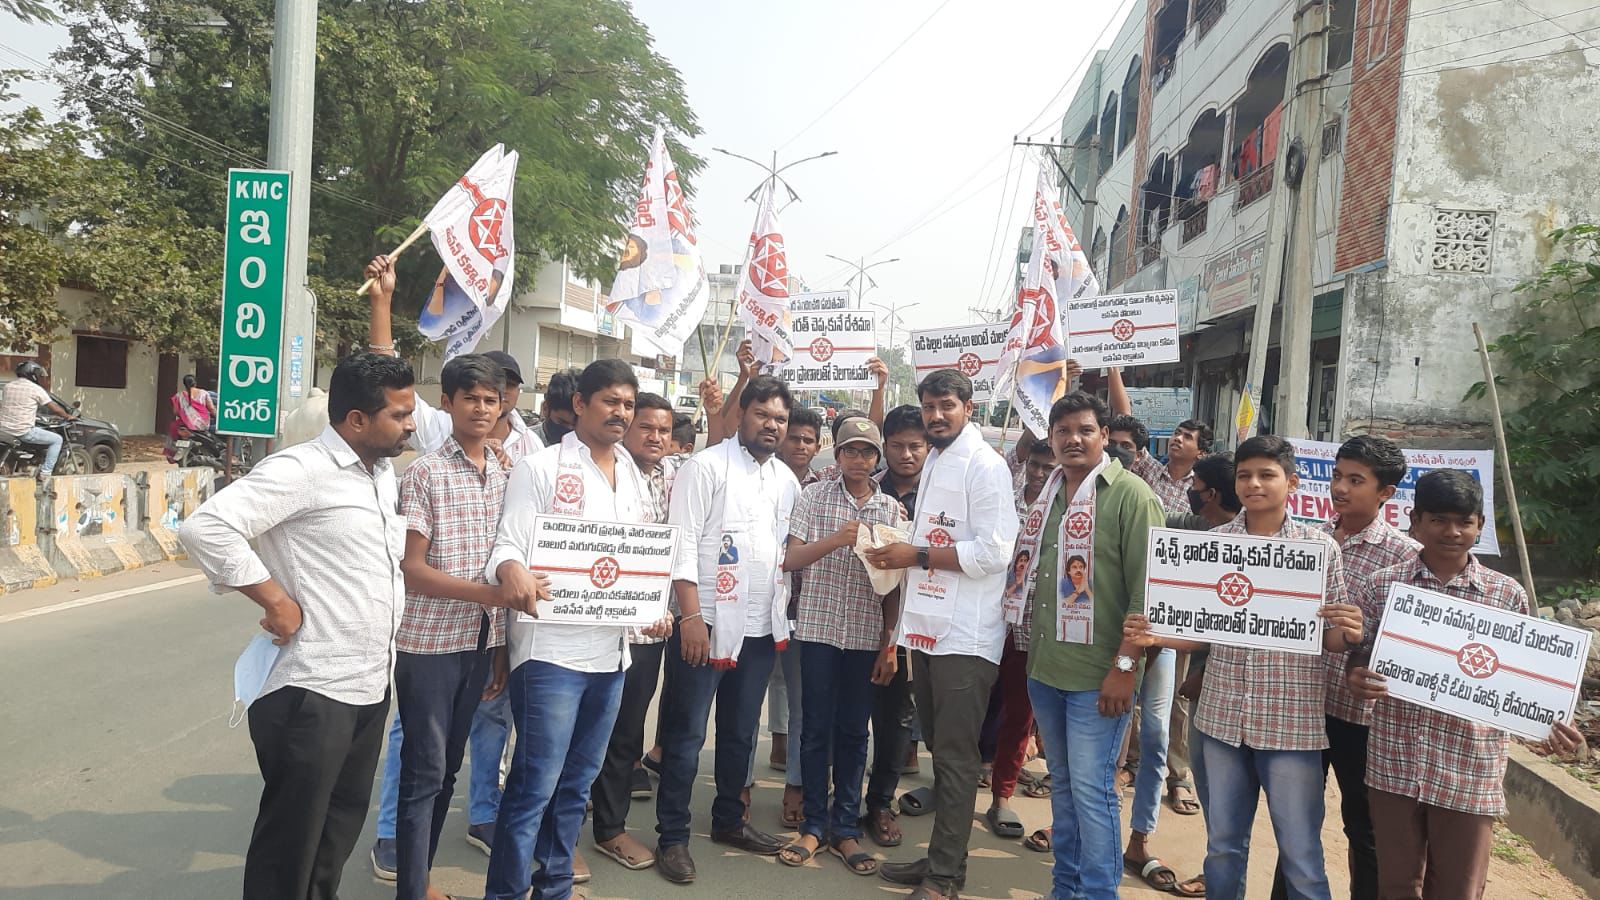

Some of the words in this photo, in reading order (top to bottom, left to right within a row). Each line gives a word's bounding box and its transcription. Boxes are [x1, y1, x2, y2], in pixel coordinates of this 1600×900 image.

[236, 181, 283, 200] KMC
[915, 336, 926, 350] బడి
[926, 336, 942, 354] పిల్లల
[943, 334, 970, 353] సమస్యలు
[971, 328, 988, 345] అంటే
[224, 398, 272, 422] నగర్
[542, 521, 575, 533] ఇందిరా
[577, 524, 597, 534] నగర్
[598, 526, 627, 540] ప్రభుత్వ
[538, 540, 567, 550] బాలుర
[617, 542, 631, 554] లేని
[632, 545, 672, 556] విషయంలో
[1184, 541, 1219, 565] భారత్
[1222, 543, 1271, 572] చెప్పుకునే
[552, 604, 583, 615] జనసేన
[584, 605, 603, 619] పార్టీ
[604, 606, 637, 619] భిక్షాటన
[1149, 601, 1166, 625] బడి
[1167, 606, 1192, 634] పిల్లల
[1194, 608, 1248, 633] ప్రాణాలతో
[1394, 594, 1413, 618] బడి
[1414, 600, 1443, 627] పిల్లల
[1442, 607, 1492, 640] సమస్యలు
[1492, 622, 1526, 644] అంటే
[1375, 659, 1416, 684] బహుశా
[1416, 669, 1449, 701] వాళ్ళకి
[1448, 680, 1472, 701] ఓటు
[1472, 684, 1501, 717] హక్కు
